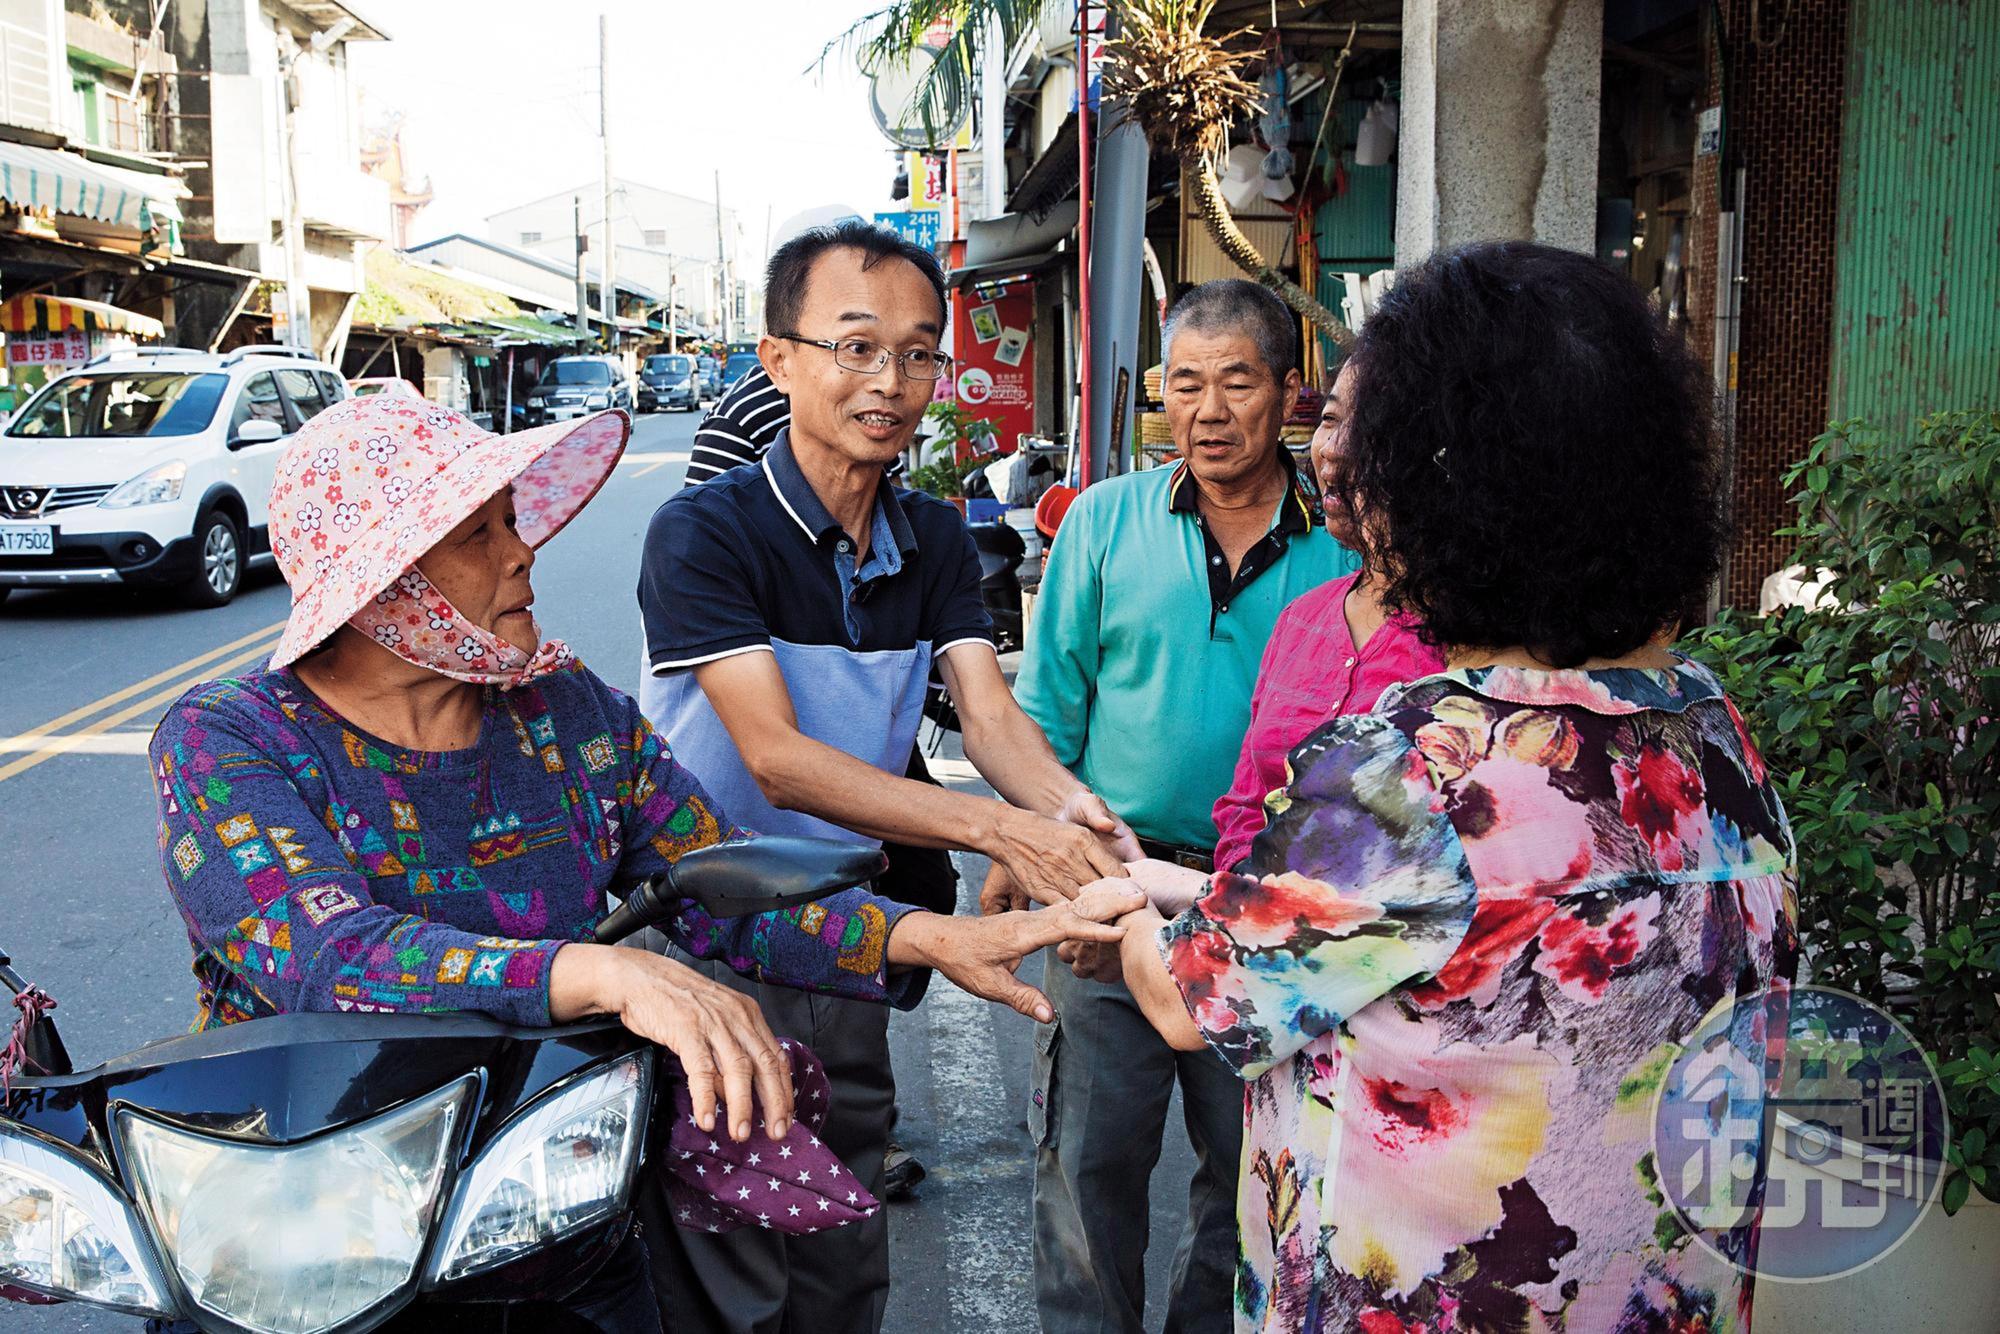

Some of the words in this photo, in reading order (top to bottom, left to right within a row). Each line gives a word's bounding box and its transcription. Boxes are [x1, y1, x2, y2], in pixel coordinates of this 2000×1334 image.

[909, 214, 939, 226] 24H
[11, 342, 67, 362] 圓仔湯
[71, 345, 86, 360] 25
